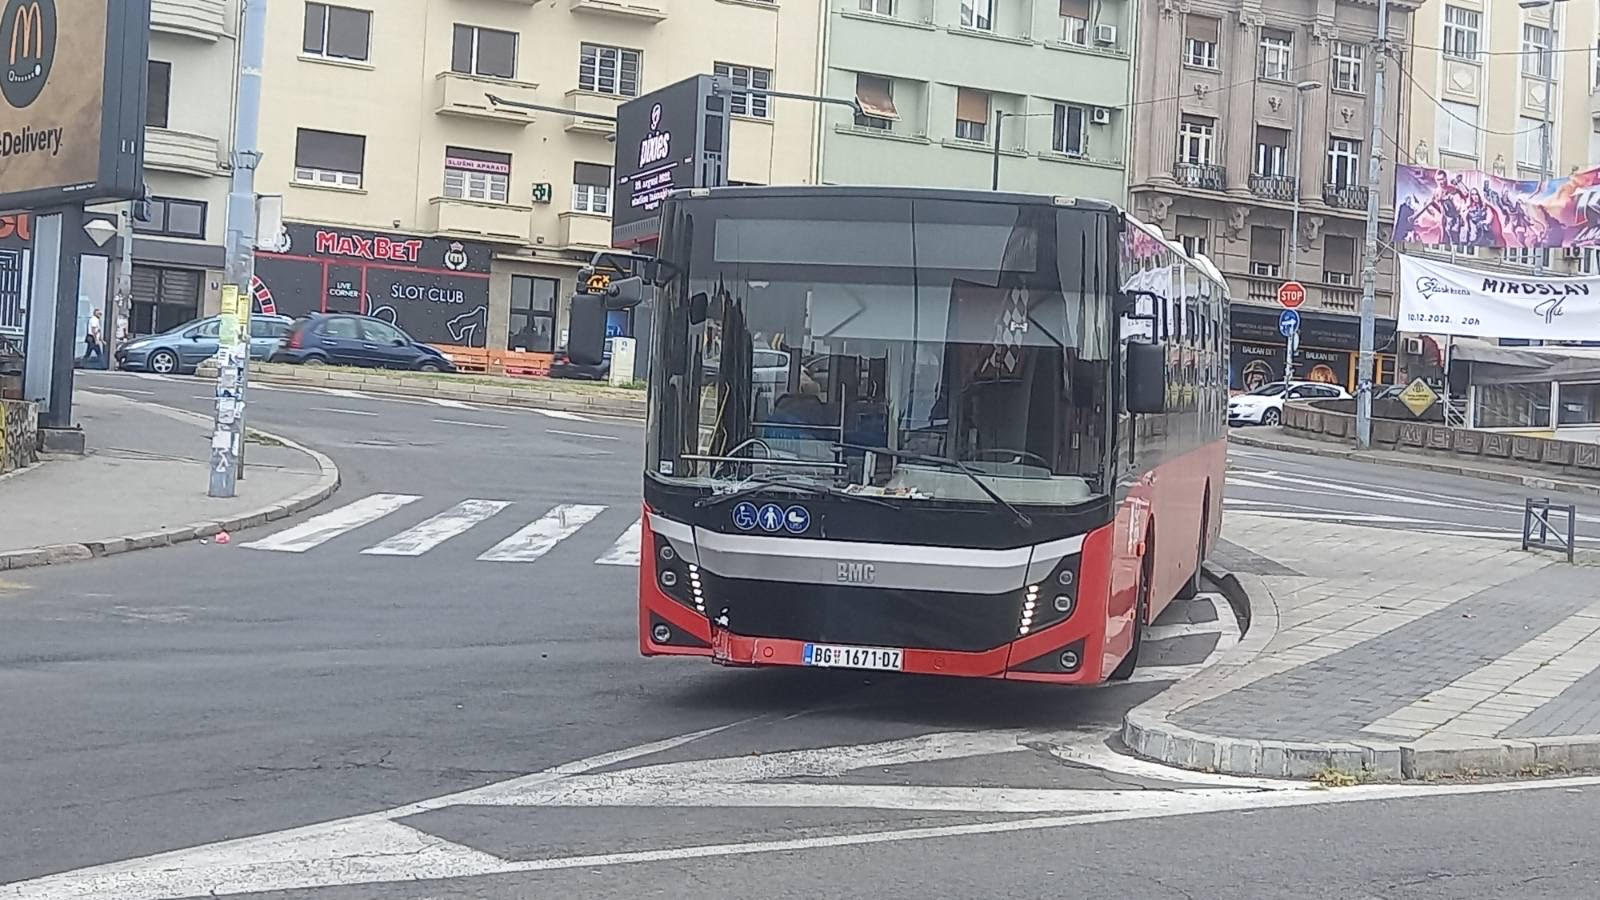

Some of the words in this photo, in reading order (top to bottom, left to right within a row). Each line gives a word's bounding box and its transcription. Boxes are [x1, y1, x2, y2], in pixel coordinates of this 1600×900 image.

[0, 126, 63, 156] Delivery
[639, 131, 670, 168] pixies
[476, 162, 507, 172] APARATI
[391, 283, 425, 300] SLOT
[428, 287, 464, 303] CLUB
[1481, 278, 1590, 296] MIROSLAV
[1281, 291, 1302, 301] STOP
[1461, 317, 1480, 326] 20h
[1242, 345, 1265, 355] BALKAN
[1305, 351, 1327, 360] BALKAN
[837, 561, 875, 583] BMC
[815, 647, 832, 663] BG
